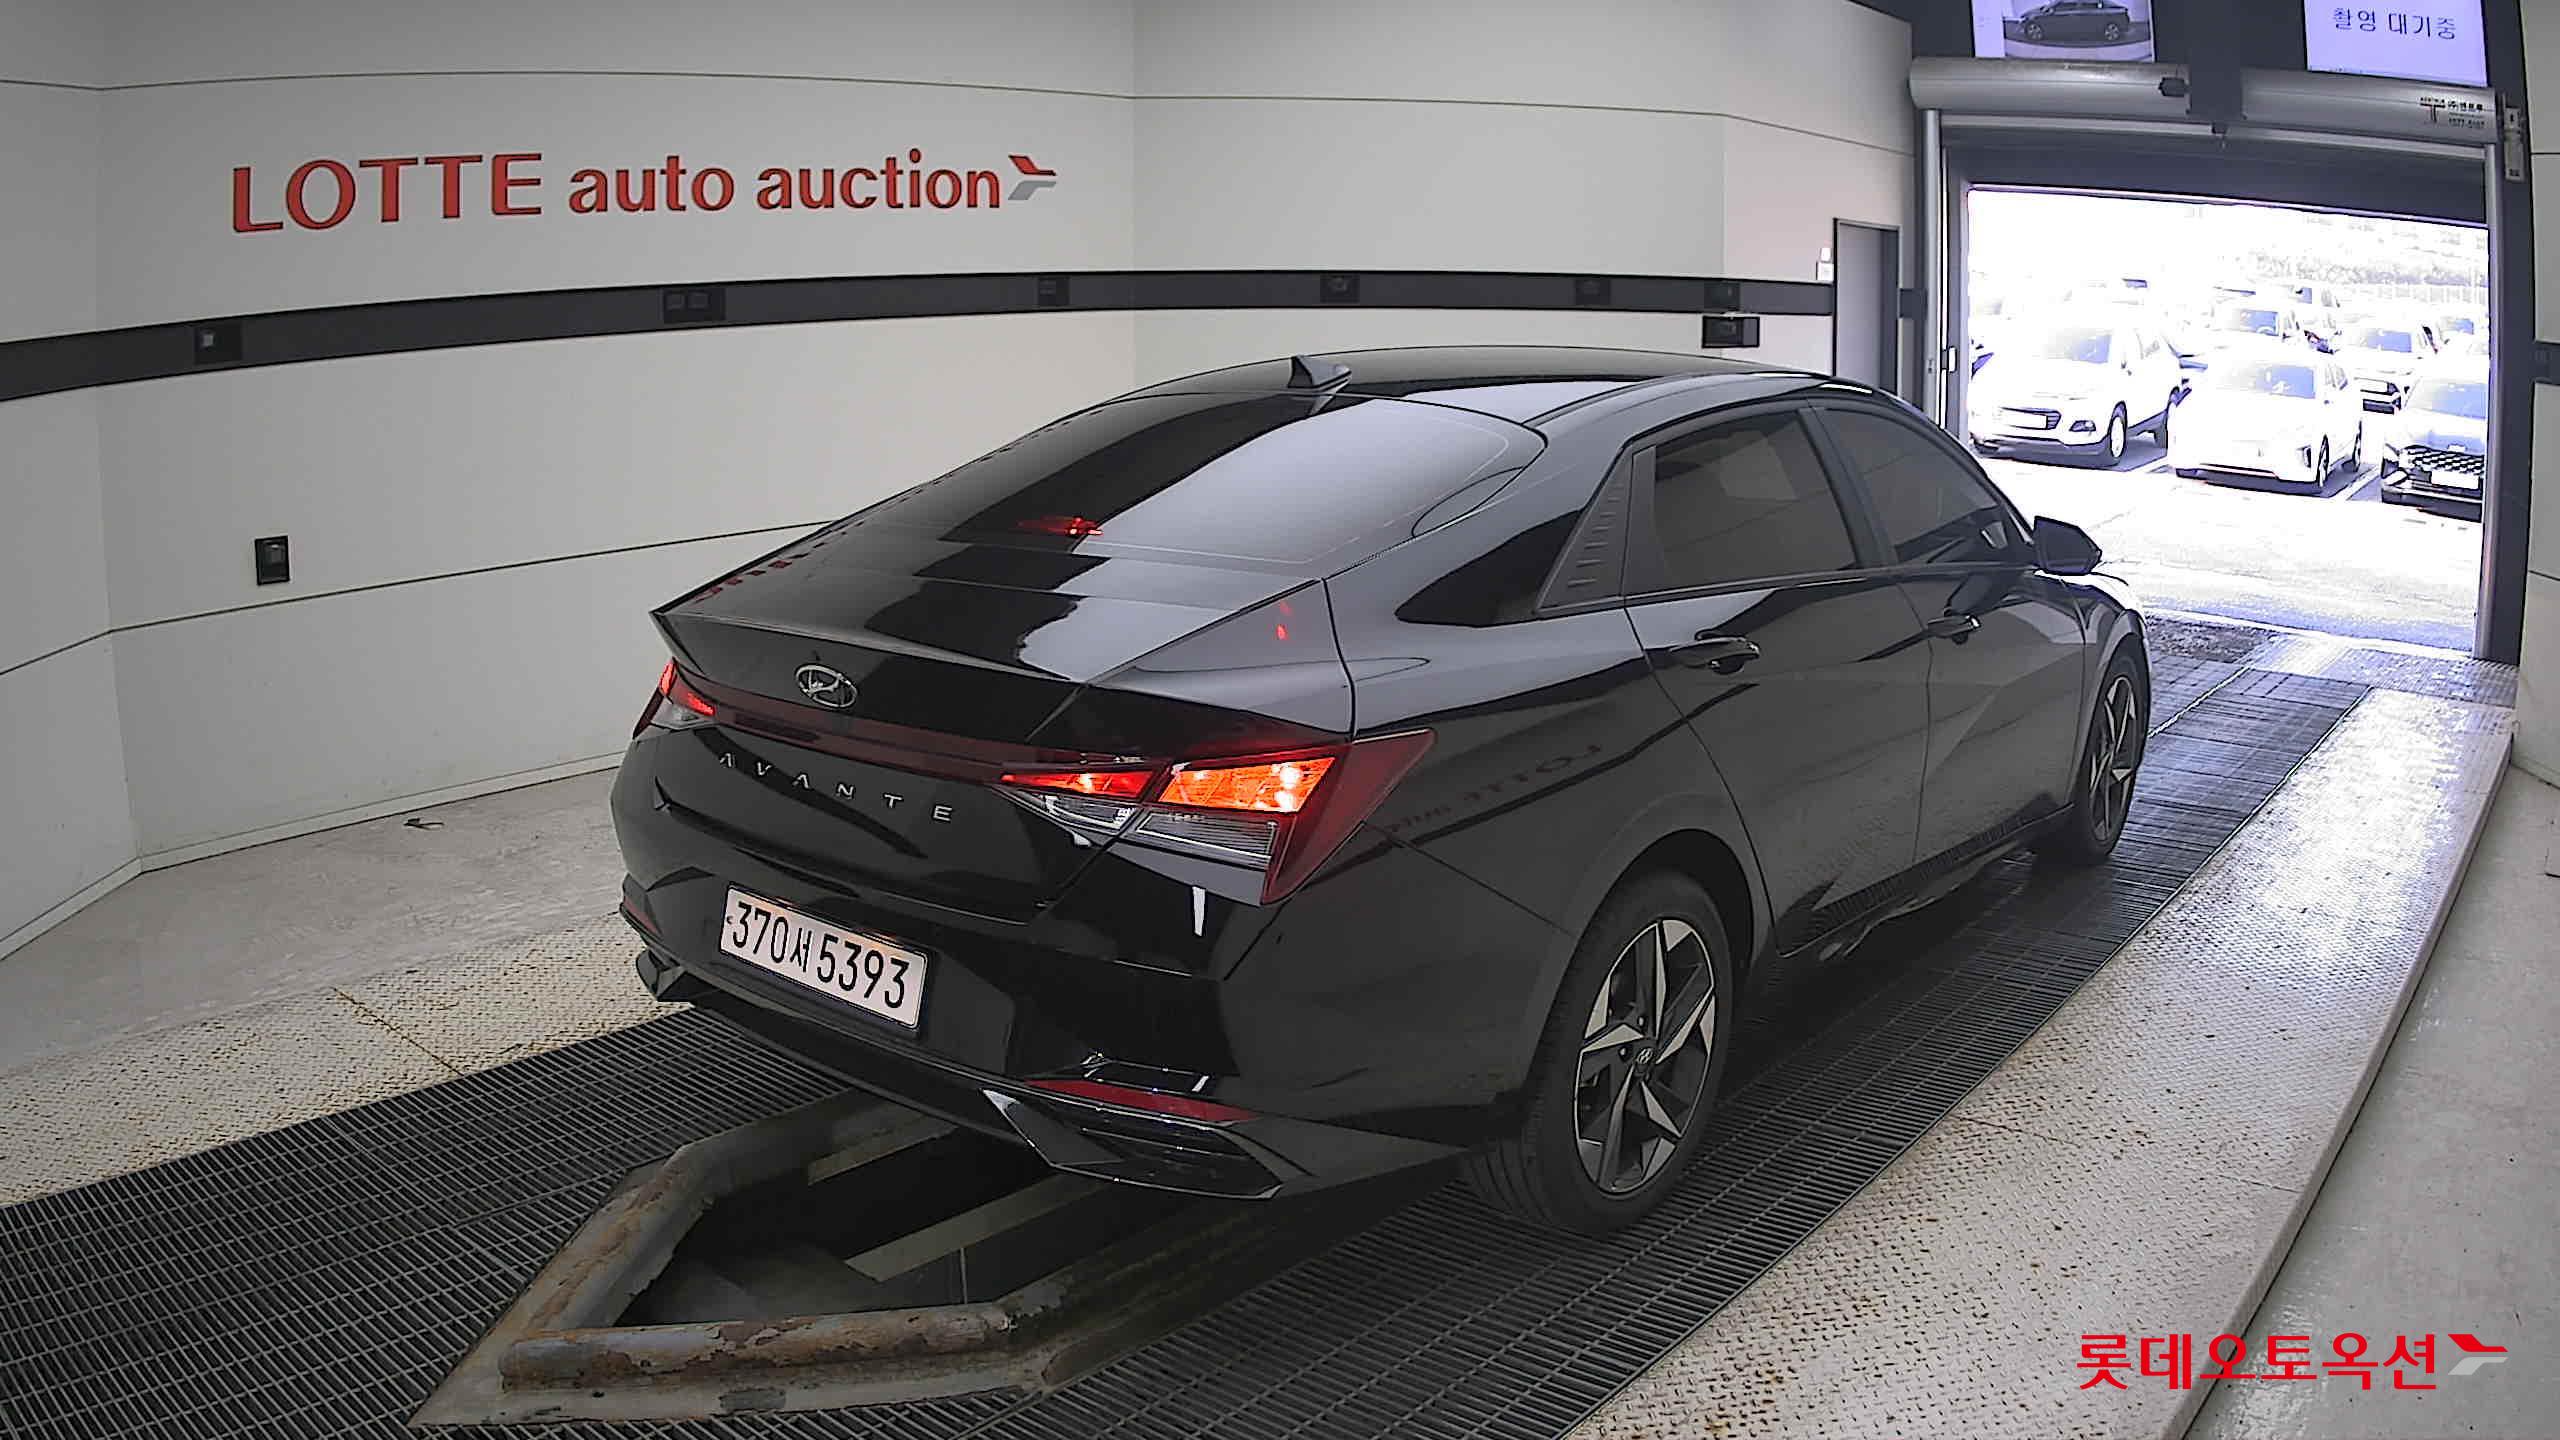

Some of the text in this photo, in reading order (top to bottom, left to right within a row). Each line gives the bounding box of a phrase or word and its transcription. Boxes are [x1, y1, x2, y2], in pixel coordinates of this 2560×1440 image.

[2333, 7, 2457, 41] 촬영 대기중
[232, 148, 1002, 233] LOTTE auto auction
[719, 752, 953, 822] AVANTE
[732, 900, 910, 1009] 370서5393
